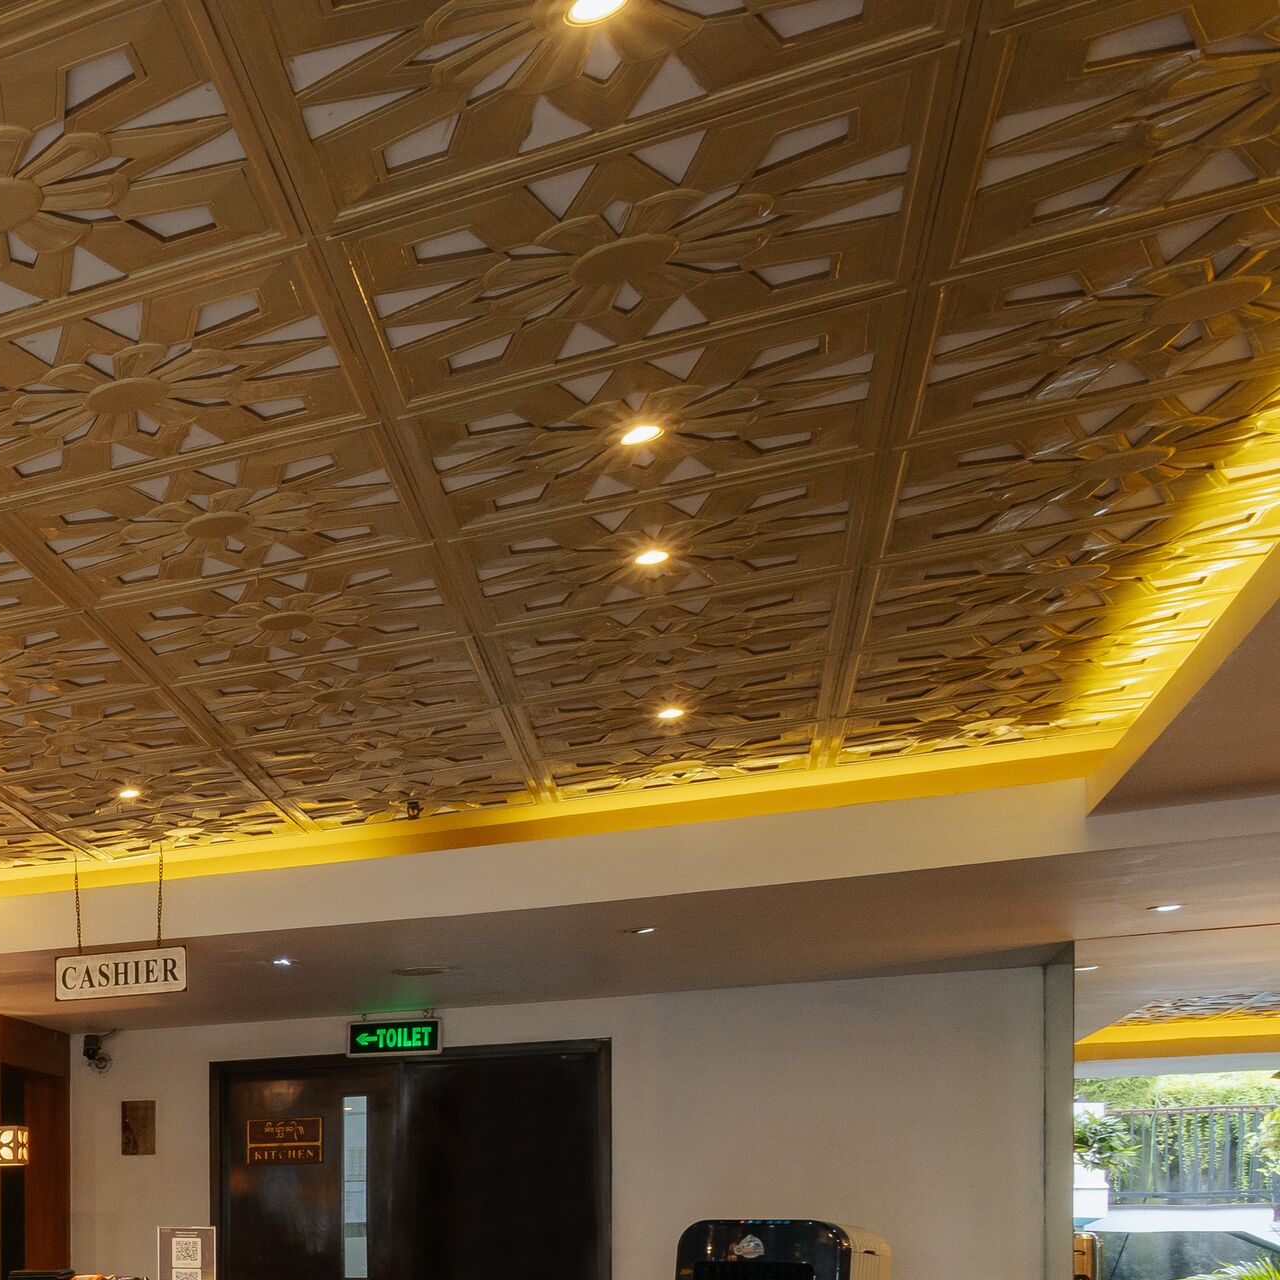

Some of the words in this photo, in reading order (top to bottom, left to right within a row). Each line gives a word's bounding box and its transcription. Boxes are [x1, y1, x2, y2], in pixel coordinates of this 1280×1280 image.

[61, 957, 180, 990] CASHIER
[376, 1026, 432, 1048] TOILET
[254, 1149, 314, 1160] KITCHEN
